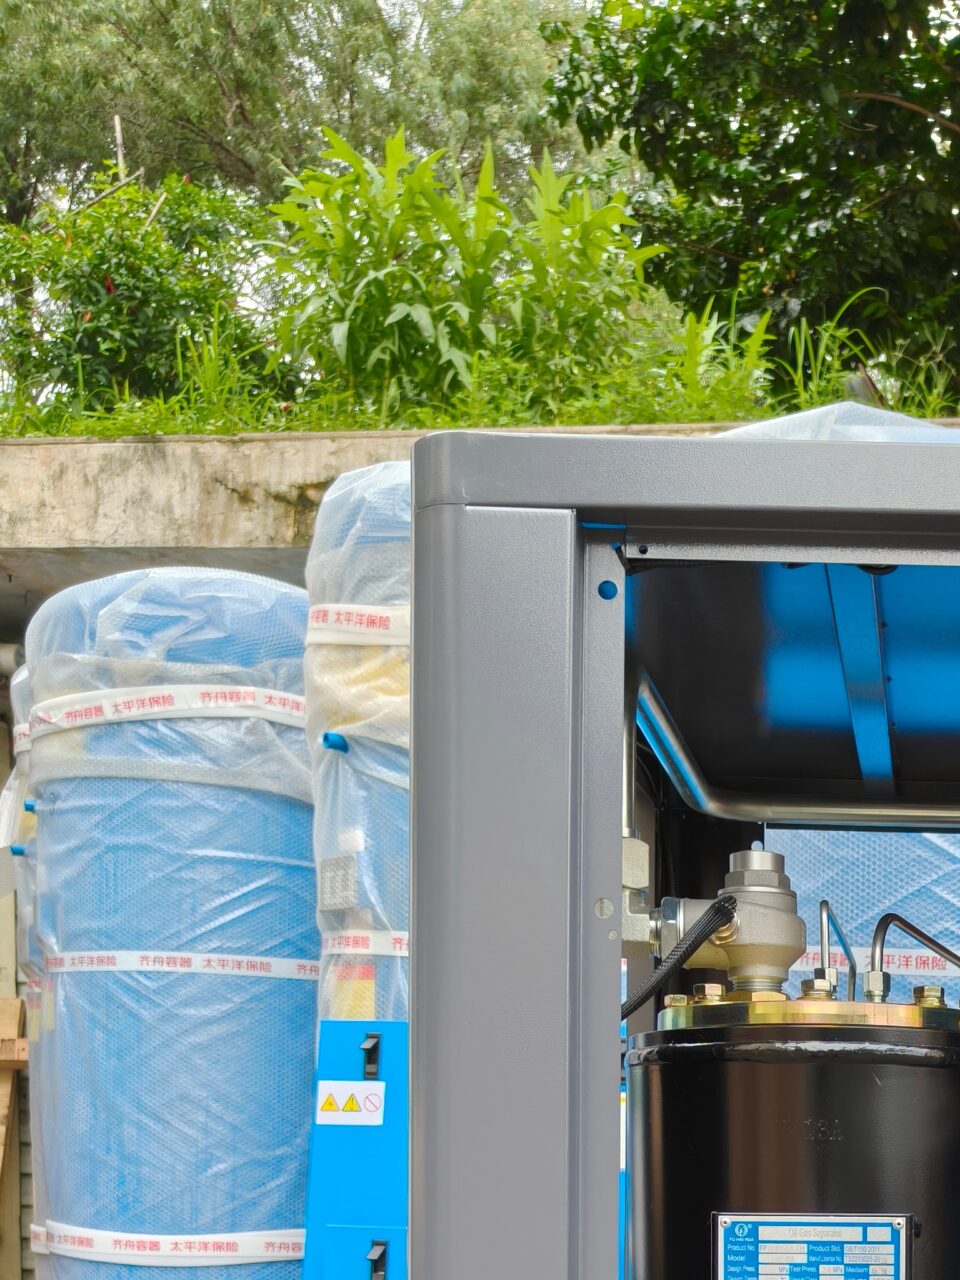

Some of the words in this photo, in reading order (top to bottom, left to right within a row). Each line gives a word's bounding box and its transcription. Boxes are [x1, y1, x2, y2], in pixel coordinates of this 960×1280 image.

[334, 610, 391, 630] 太平洋保险
[112, 694, 175, 714] 太平洋保险
[202, 959, 272, 973] 太平洋保险
[112, 1239, 160, 1252] 齐舟容器
[170, 1241, 239, 1253] 太平洋保险
